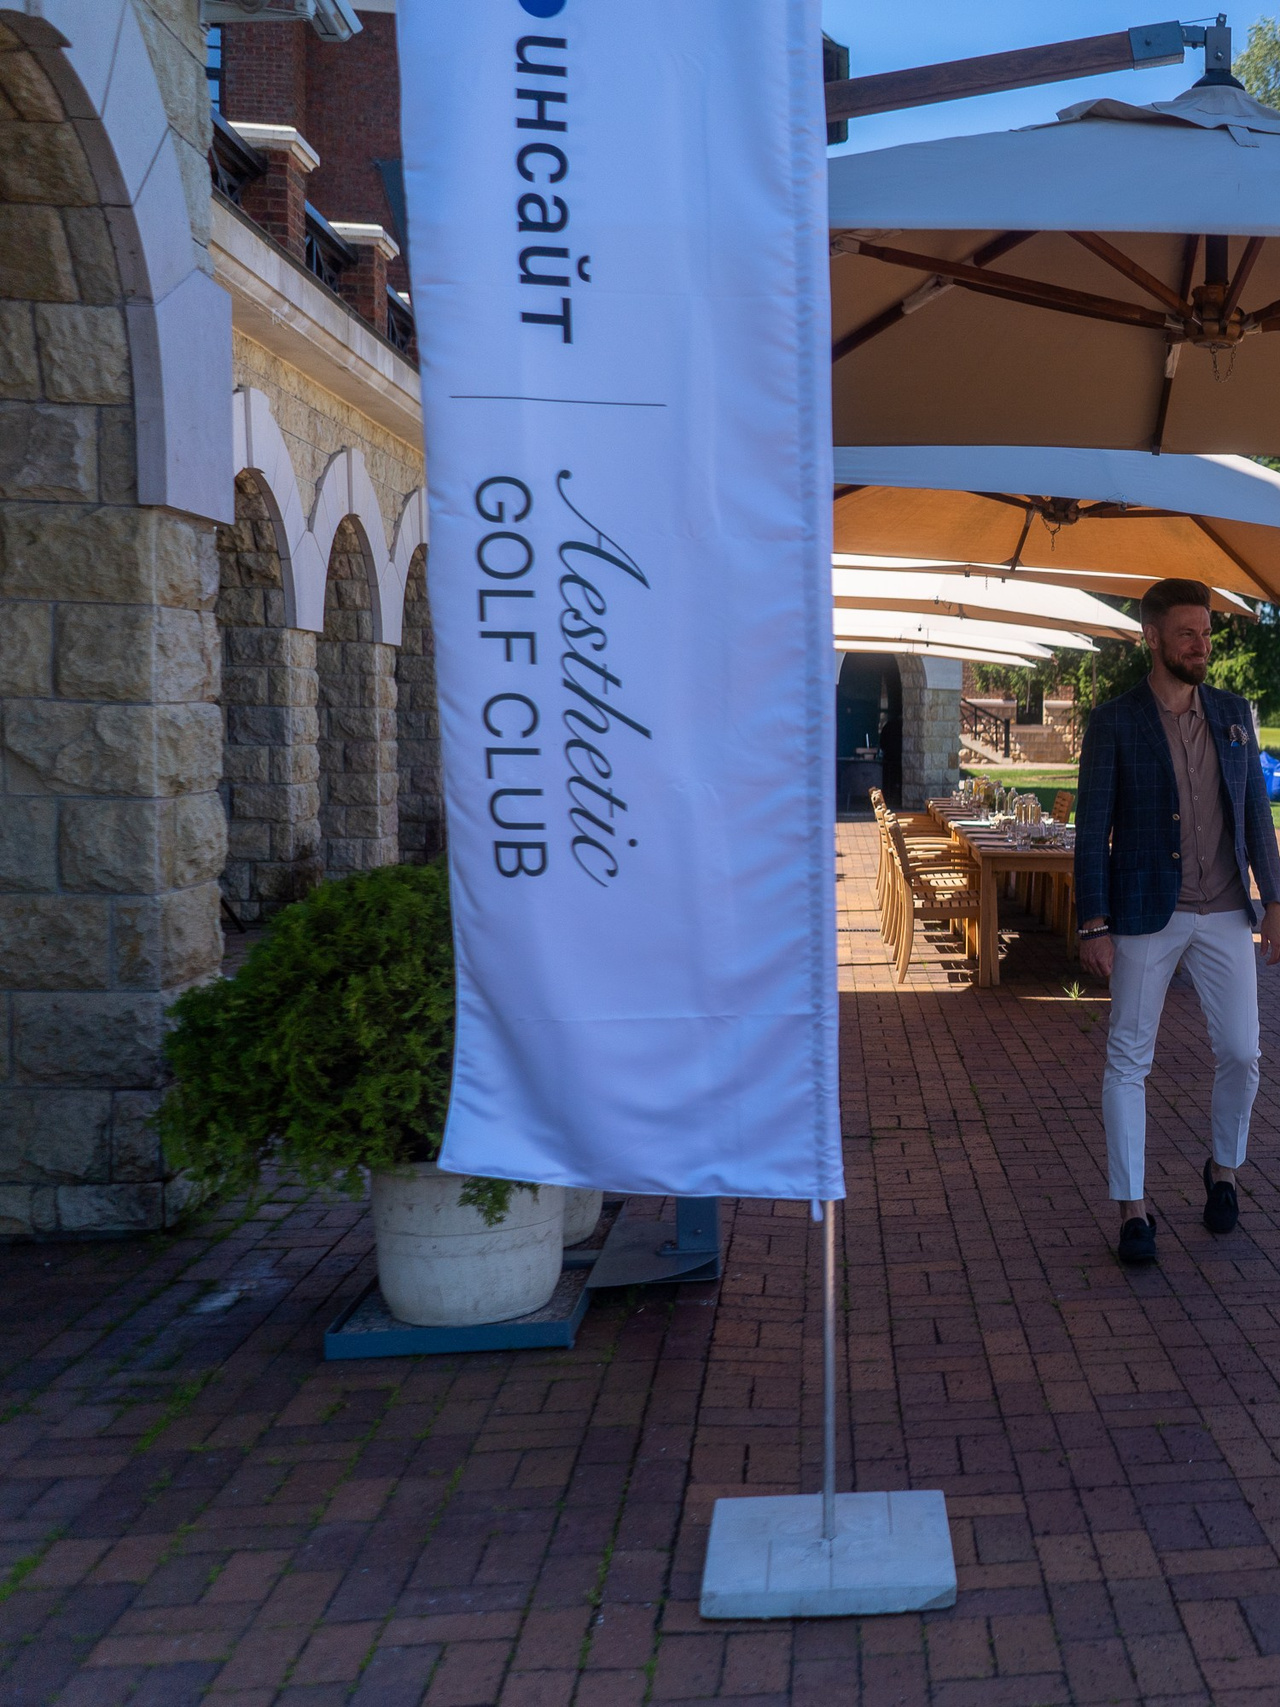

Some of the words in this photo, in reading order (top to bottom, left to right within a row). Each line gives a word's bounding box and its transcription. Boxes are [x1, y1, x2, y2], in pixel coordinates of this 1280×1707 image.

[515, 35, 592, 344] инсайт
[474, 475, 537, 665] GOLF
[557, 470, 652, 887] Aesthetic
[483, 692, 548, 878] CLUB
